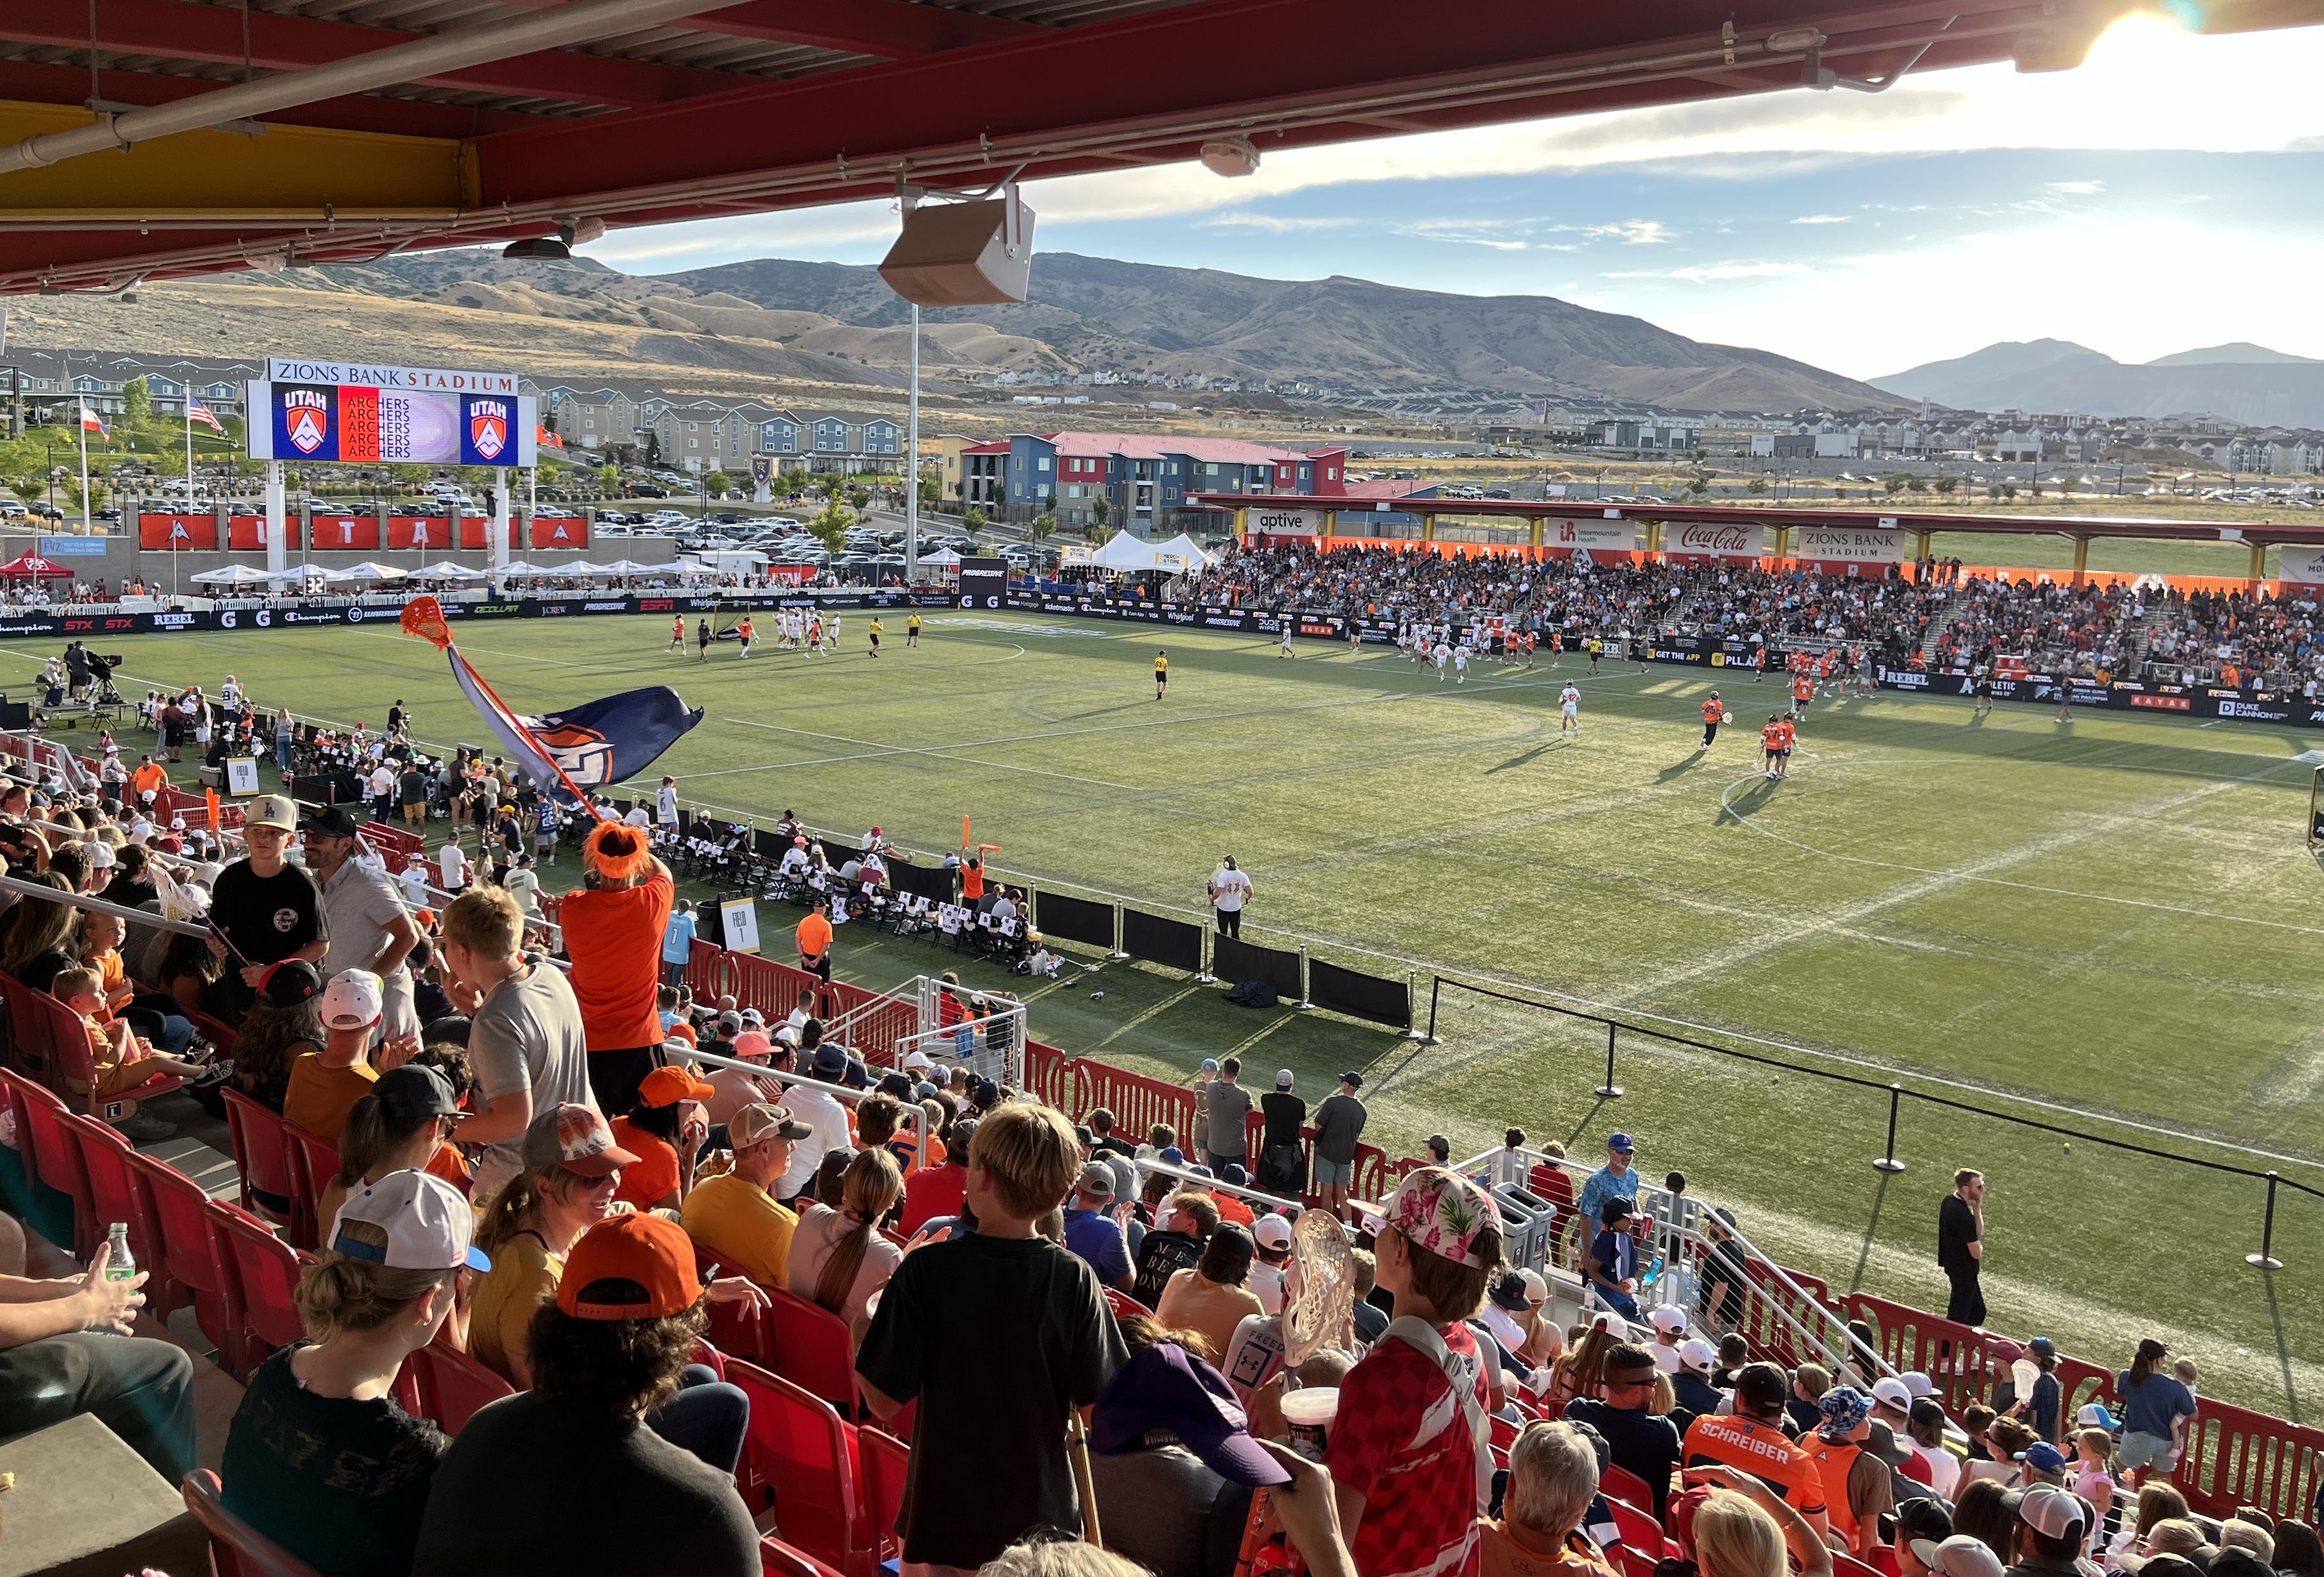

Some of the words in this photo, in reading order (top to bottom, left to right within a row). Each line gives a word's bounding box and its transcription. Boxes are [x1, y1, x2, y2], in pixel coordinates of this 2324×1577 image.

[278, 363, 339, 382] ZIONS
[348, 368, 405, 386] BANK
[408, 373, 512, 392] STADIUM
[285, 390, 327, 410] UTAH
[347, 397, 409, 410] ARCHERS
[348, 409, 410, 422] ARCHERS
[470, 401, 506, 419] UTAH
[348, 421, 410, 434] ARCHERS
[348, 433, 410, 446] ARCHERS
[348, 445, 410, 458] ARCHERS
[1260, 513, 1303, 531] aptive
[1578, 529, 1622, 537] Intermountain
[1681, 524, 1751, 551] Coca-Cola
[1806, 533, 1848, 544] ZIONS
[1855, 535, 1896, 547] BANK
[1822, 548, 1878, 557] STADIUM
[961, 569, 1005, 577] PROGRESSIVE
[307, 576, 324, 594] 32
[584, 602, 627, 610] PROGRESSIVE
[640, 600, 674, 611] ESPN
[780, 598, 816, 607] ticketmaster
[1044, 603, 1076, 612] ticketmaster
[153, 613, 195, 625] REBEL
[1168, 612, 1195, 622] Whirlpool
[1205, 618, 1241, 626] PROGRESSIVE
[65, 620, 94, 630] STX
[104, 618, 134, 629] STX
[1301, 626, 1332, 634] KAYAK
[1655, 651, 1670, 659] GET
[1671, 652, 1685, 660] THE
[1887, 672, 1929, 686] REBEL
[2134, 697, 2187, 707] KAYAK
[2236, 702, 2259, 711] DUKE
[2235, 709, 2274, 719] CANNON
[236, 765, 249, 776] FIELD
[242, 777, 245, 787] 2
[660, 800, 666, 812] 6
[732, 911, 747, 928] FIELD
[672, 928, 679, 945] 1
[740, 928, 744, 942] 1
[1249, 1330, 1285, 1352] FREED
[1699, 1422, 1789, 1465] SCHREIBER
